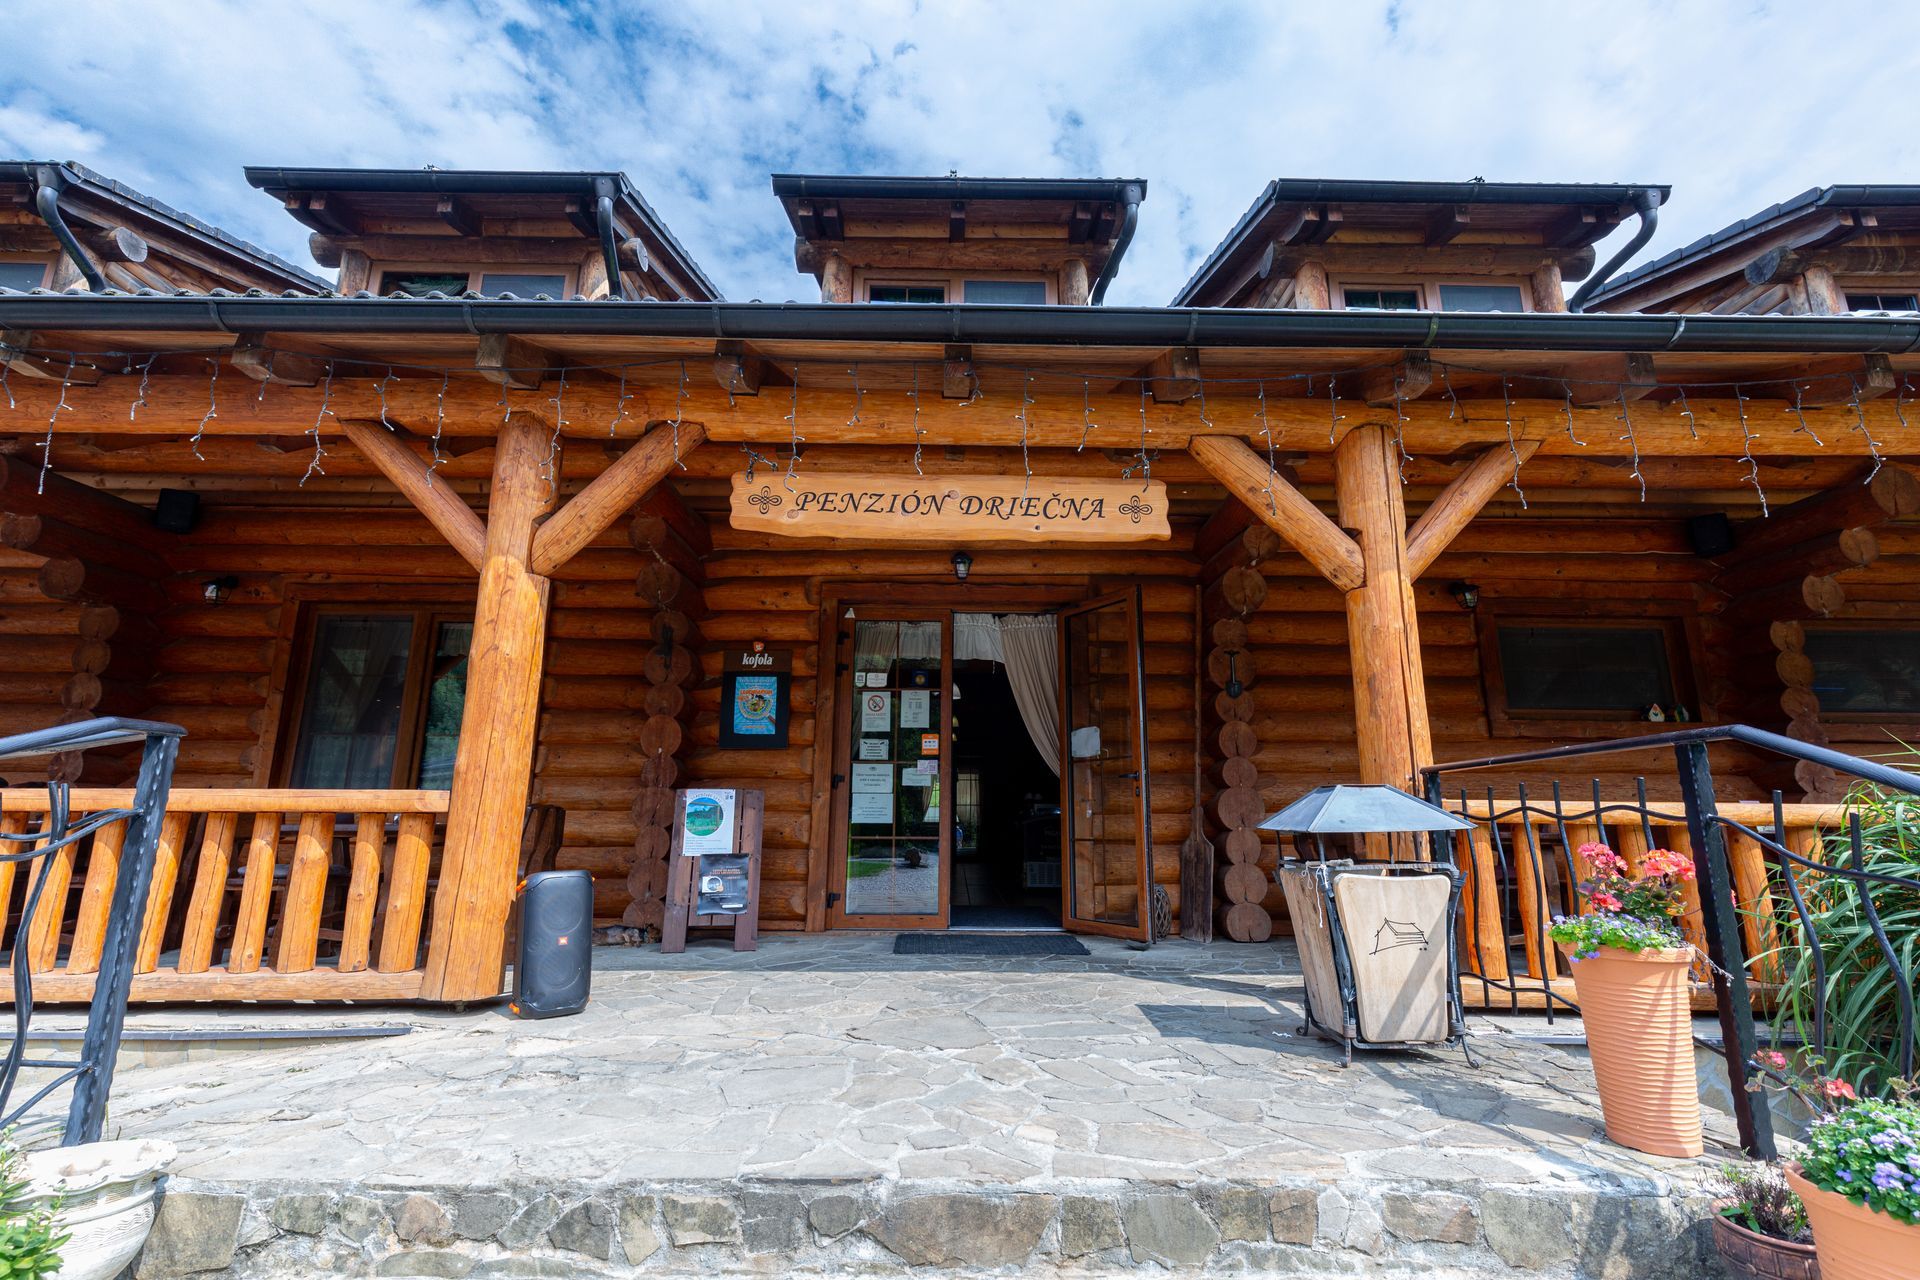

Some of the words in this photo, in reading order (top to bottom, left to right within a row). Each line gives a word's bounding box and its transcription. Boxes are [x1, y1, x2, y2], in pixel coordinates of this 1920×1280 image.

[795, 490, 951, 516] PENZIÓN
[959, 493, 1106, 521] DRIEČNA
[742, 653, 773, 668] kofola
